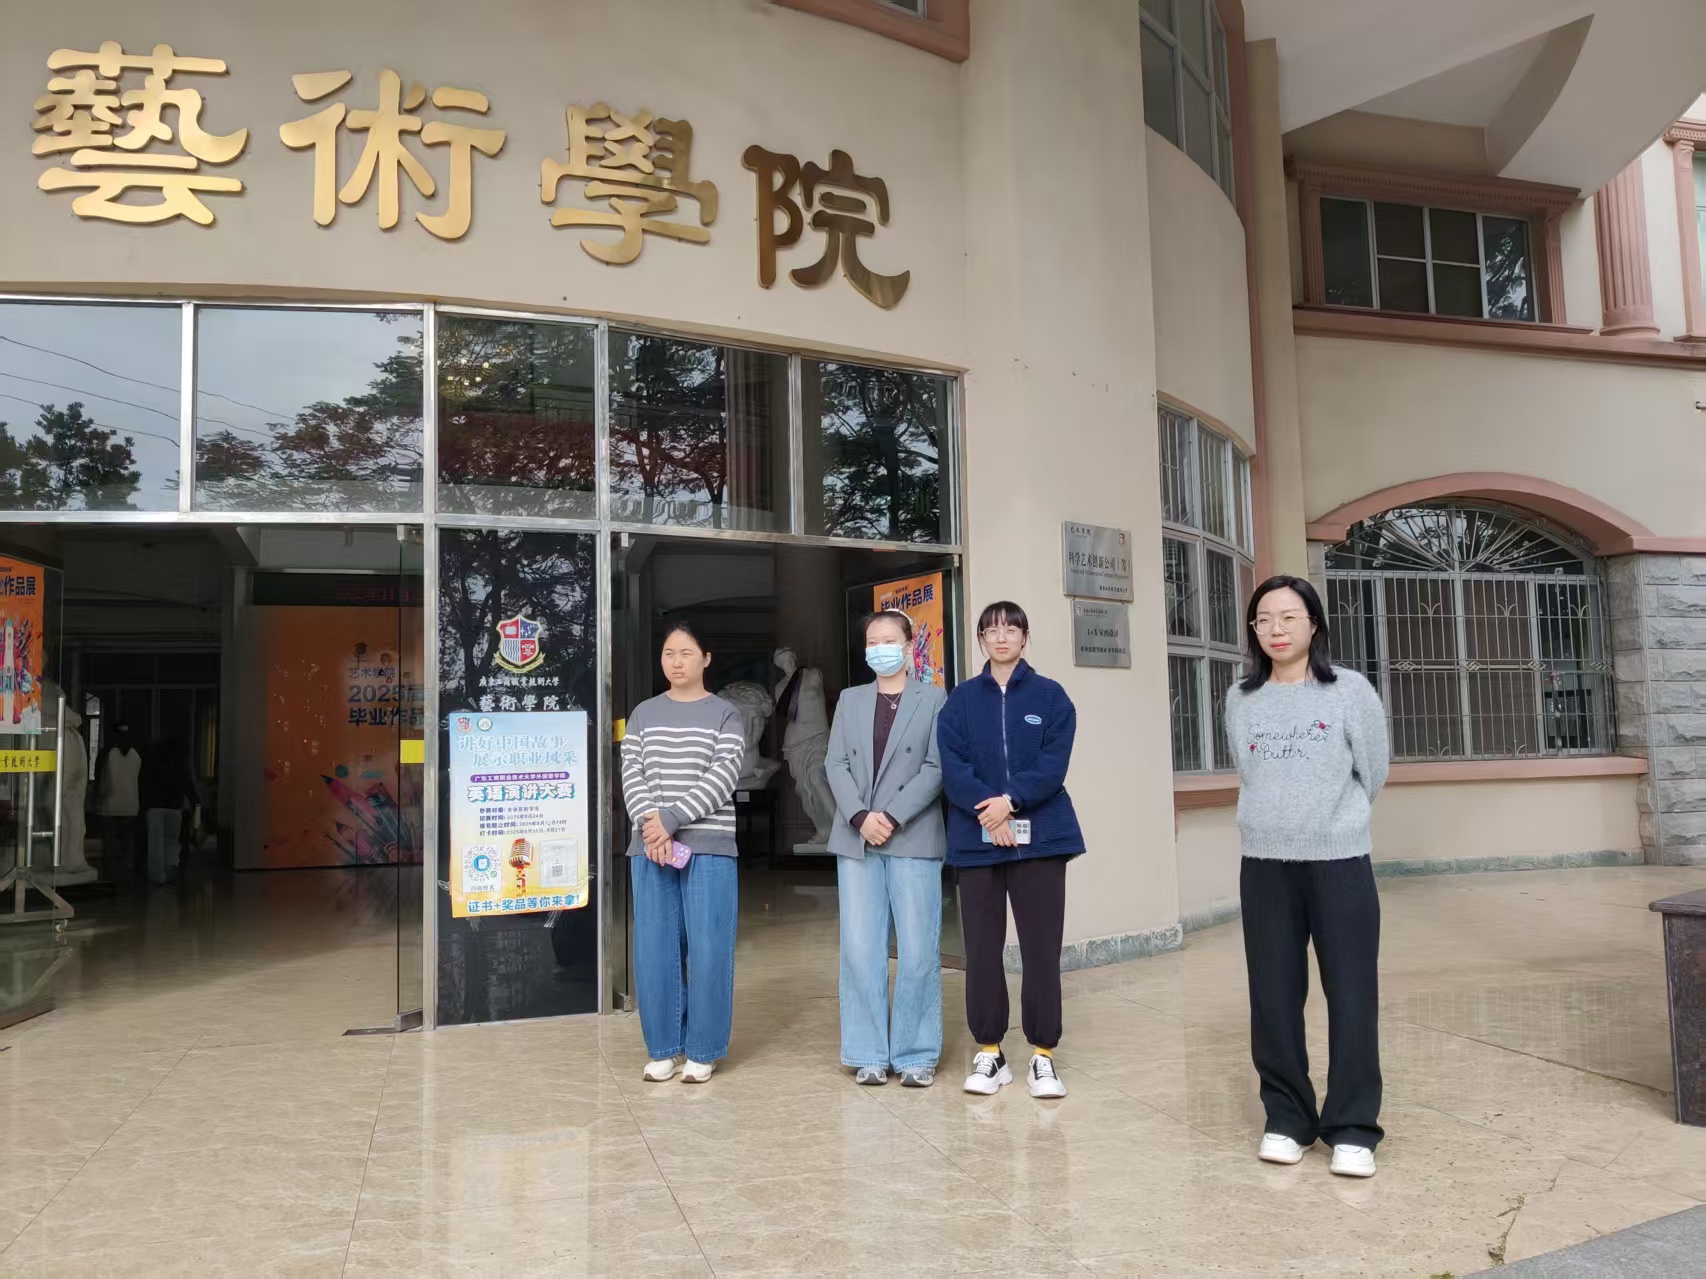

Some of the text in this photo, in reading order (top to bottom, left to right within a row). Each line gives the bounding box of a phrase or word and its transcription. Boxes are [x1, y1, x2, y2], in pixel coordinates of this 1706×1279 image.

[31, 40, 911, 309] 藝術學院
[0, 575, 36, 596] 作品展
[479, 694, 560, 711] 藝術學院
[467, 782, 575, 803] 英语演讲大赛
